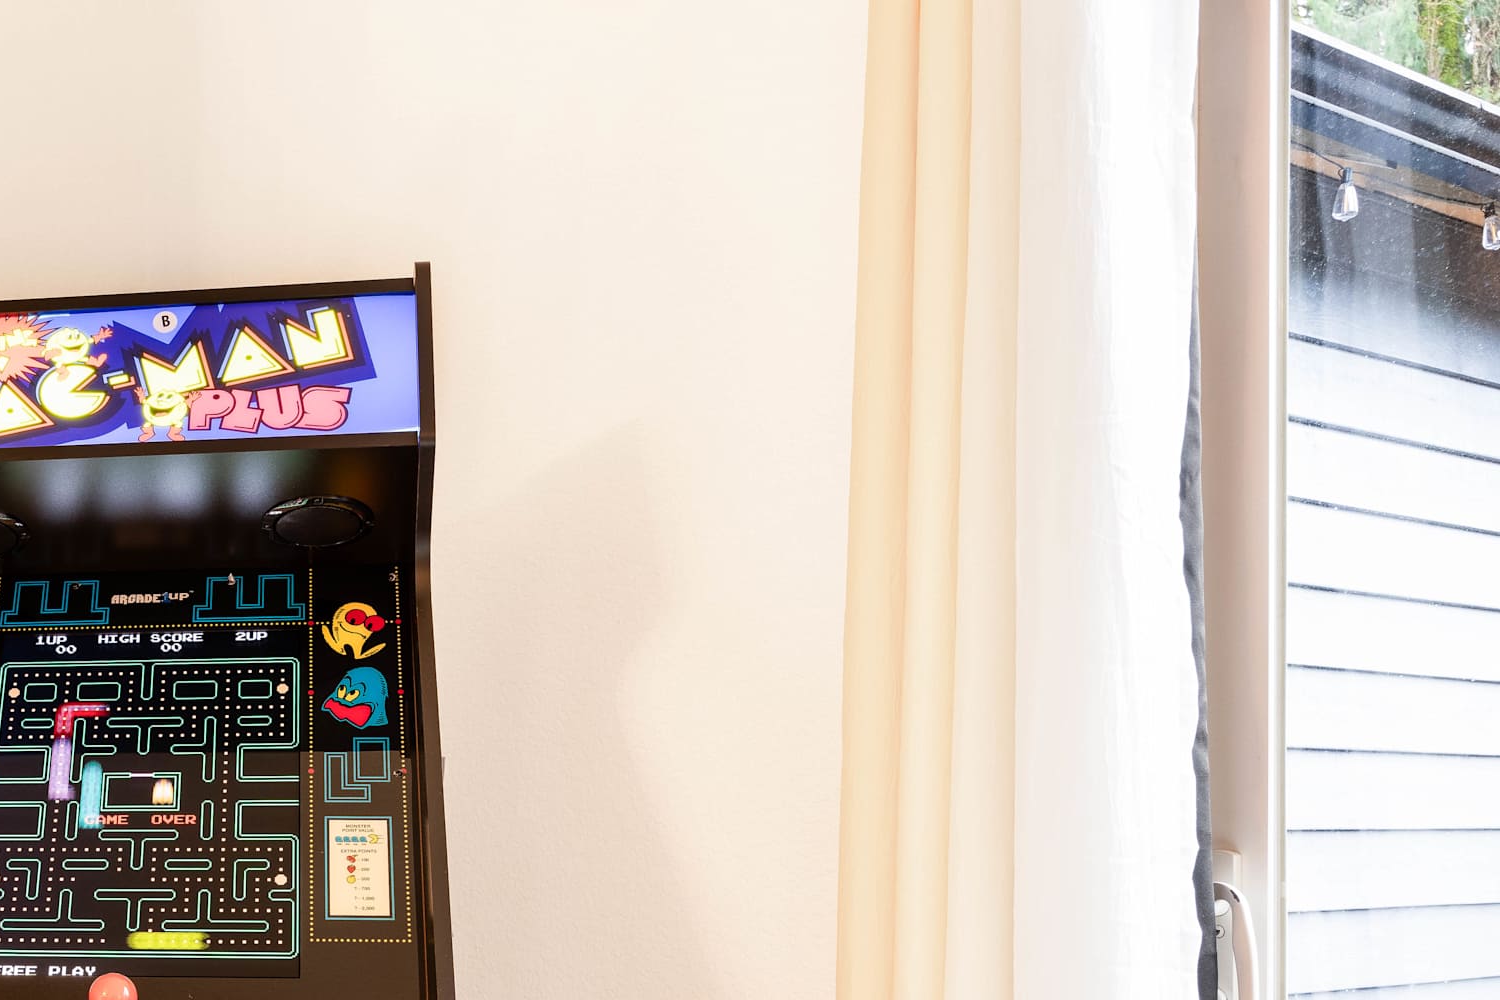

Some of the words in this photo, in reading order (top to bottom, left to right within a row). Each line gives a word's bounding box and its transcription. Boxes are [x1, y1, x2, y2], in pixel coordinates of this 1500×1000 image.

[188, 384, 351, 433] PLUS
[35, 635, 67, 645] 1UP
[97, 634, 140, 644] HIGH
[150, 633, 203, 642] SCORE
[235, 631, 268, 641] 2UP
[84, 814, 129, 825] GAME
[151, 814, 197, 825] OVER
[47, 964, 97, 976] PLAY
